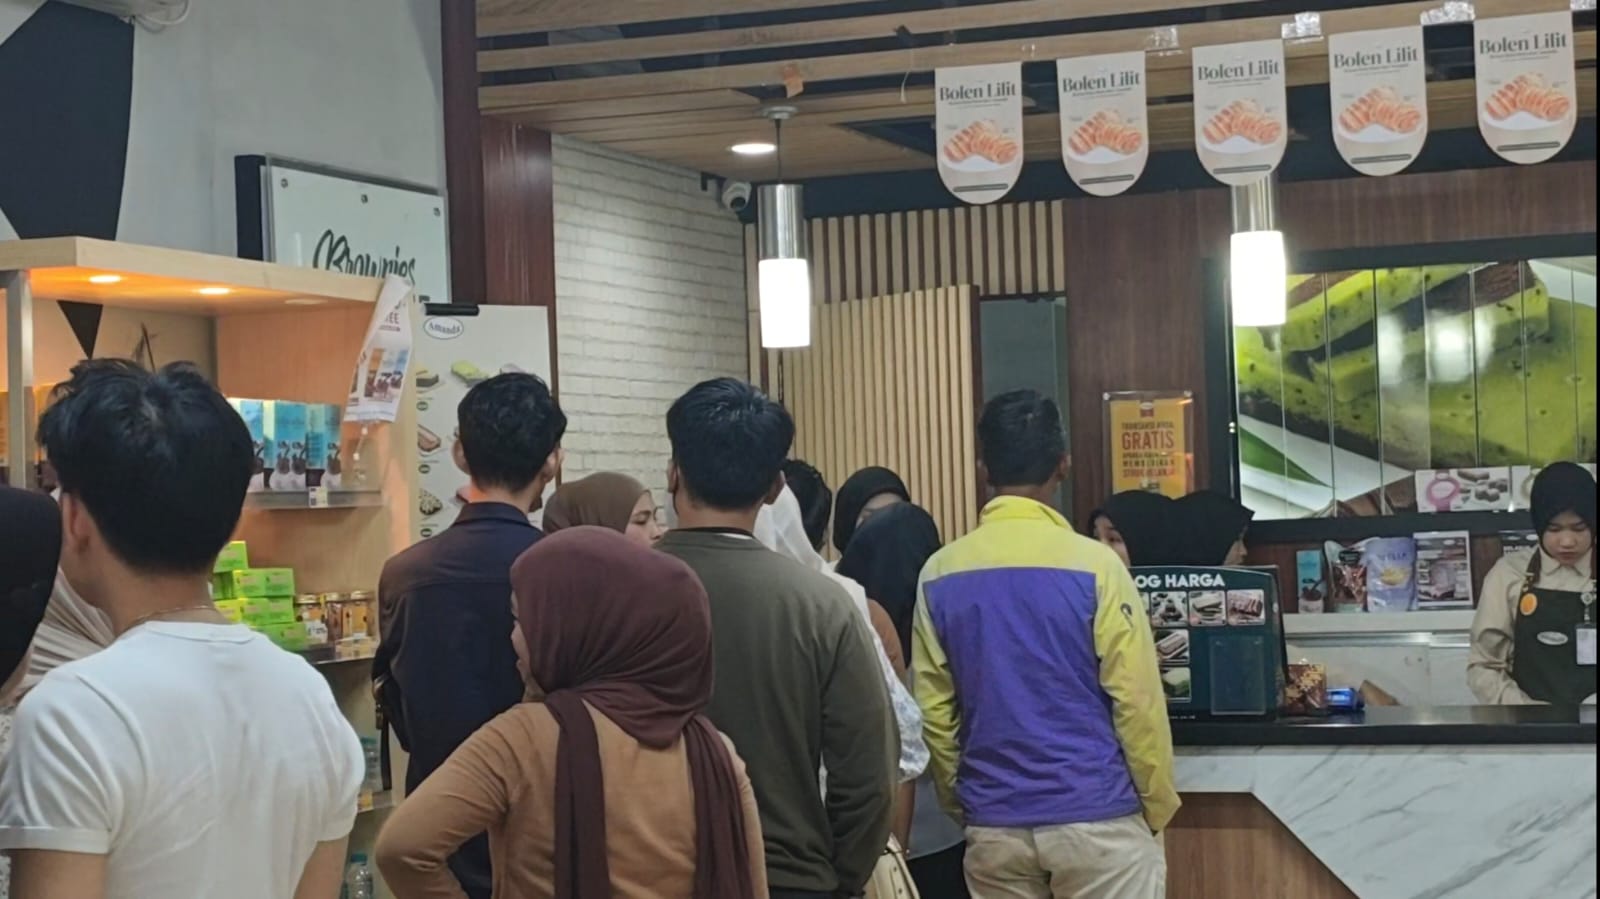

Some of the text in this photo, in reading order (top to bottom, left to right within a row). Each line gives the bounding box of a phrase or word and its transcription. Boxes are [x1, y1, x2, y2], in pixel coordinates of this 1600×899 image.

[1480, 32, 1567, 54] Bolen Lilit
[1334, 47, 1418, 69] Bolen Lilit
[1198, 60, 1279, 81] Bolen Lilit
[939, 81, 1016, 101] Bolen Lilit
[1063, 74, 1107, 93] Bolen
[1110, 71, 1140, 88] Lilit
[312, 228, 416, 286] Brownies
[429, 322, 461, 336] Amanda
[1121, 430, 1174, 450] GRATIS
[1134, 573, 1226, 589] OG HARGA
